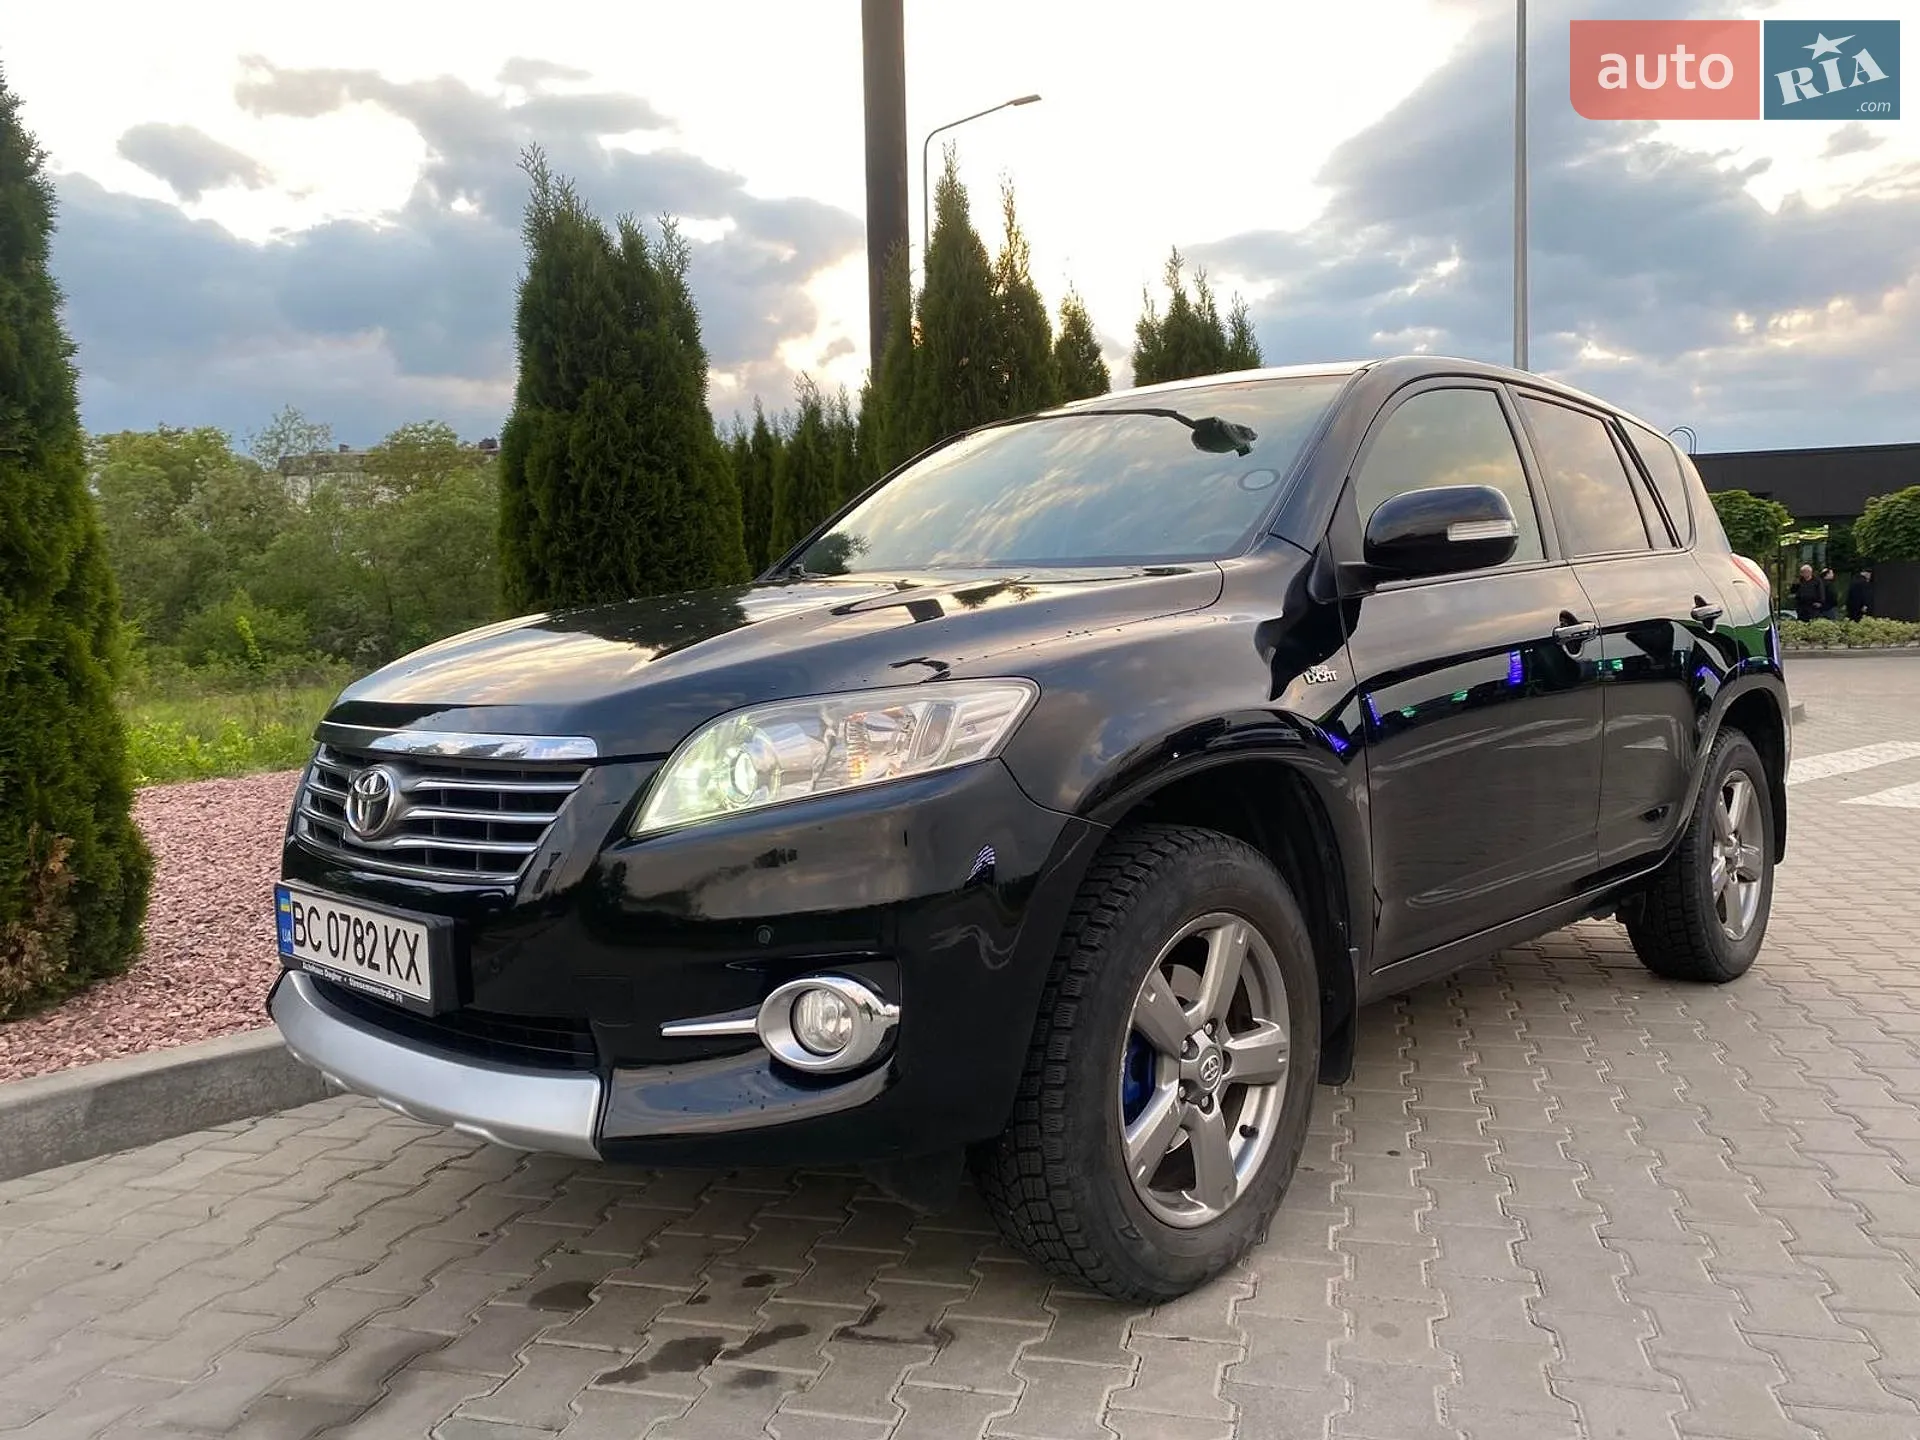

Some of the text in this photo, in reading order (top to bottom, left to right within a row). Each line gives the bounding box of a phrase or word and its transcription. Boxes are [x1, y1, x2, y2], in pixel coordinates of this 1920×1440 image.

[281, 929, 293, 944] UA
[292, 901, 322, 952] BC
[326, 910, 381, 972] 0782
[384, 925, 422, 986] KX
